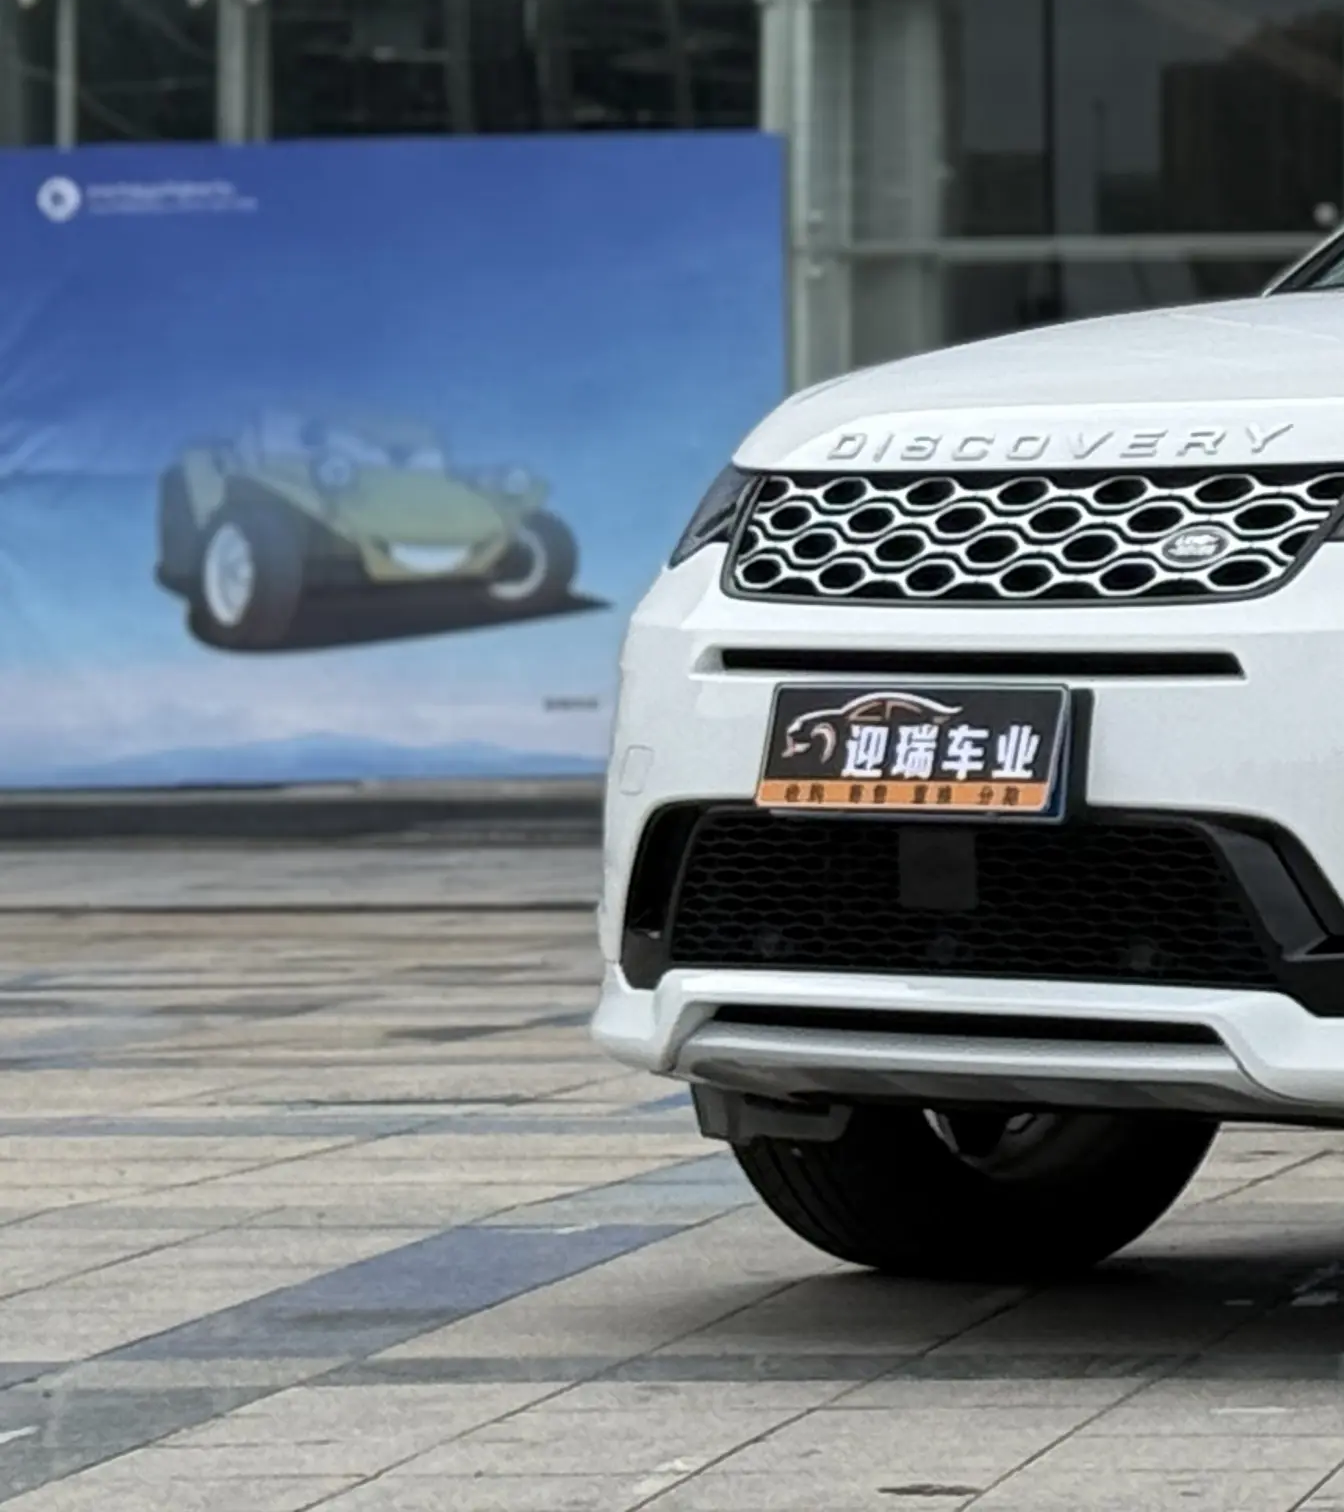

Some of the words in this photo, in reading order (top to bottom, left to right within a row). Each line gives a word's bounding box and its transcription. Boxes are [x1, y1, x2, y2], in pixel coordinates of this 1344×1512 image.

[826, 422, 1295, 463] DISCOVERY
[840, 724, 1040, 780] 迎瑞车业
